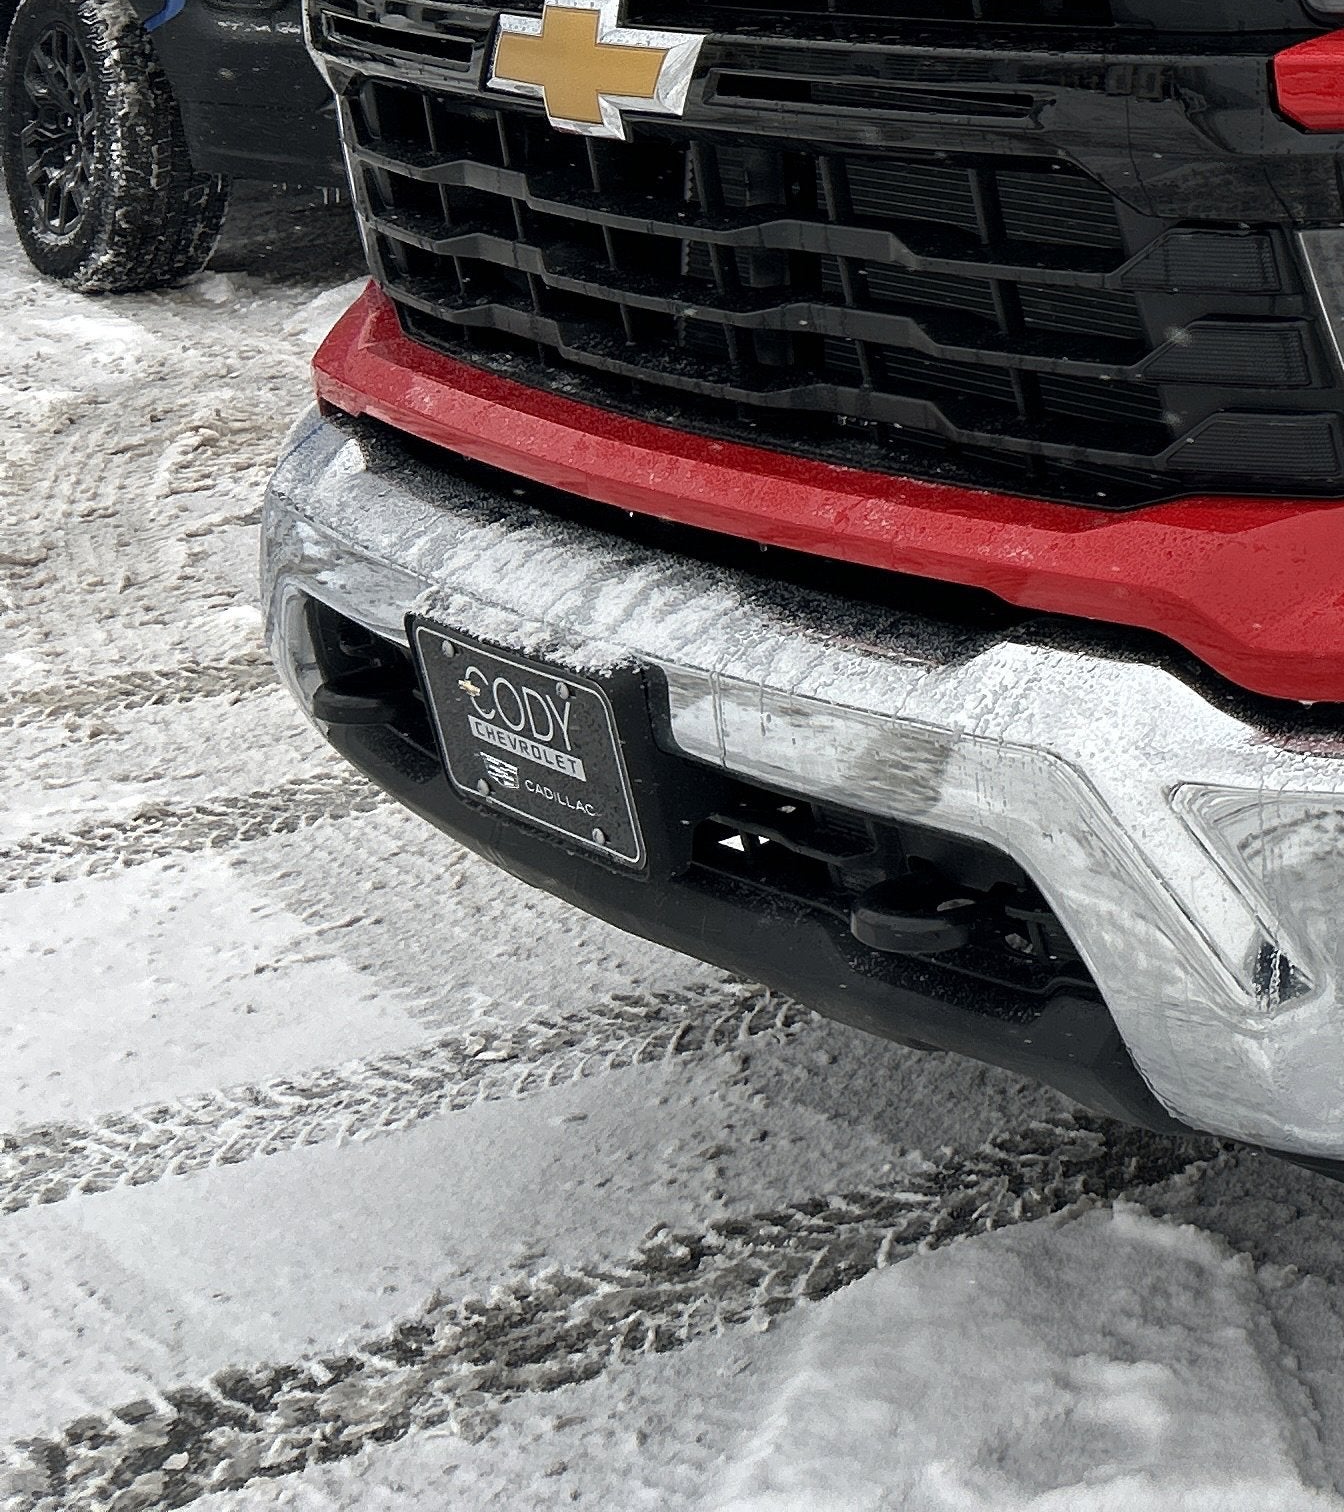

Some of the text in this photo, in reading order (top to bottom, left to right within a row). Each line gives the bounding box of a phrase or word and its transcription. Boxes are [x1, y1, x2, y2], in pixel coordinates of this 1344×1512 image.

[464, 665, 572, 751] CODY
[474, 721, 578, 776] CHEVROLET
[524, 779, 596, 817] CADILLAC
